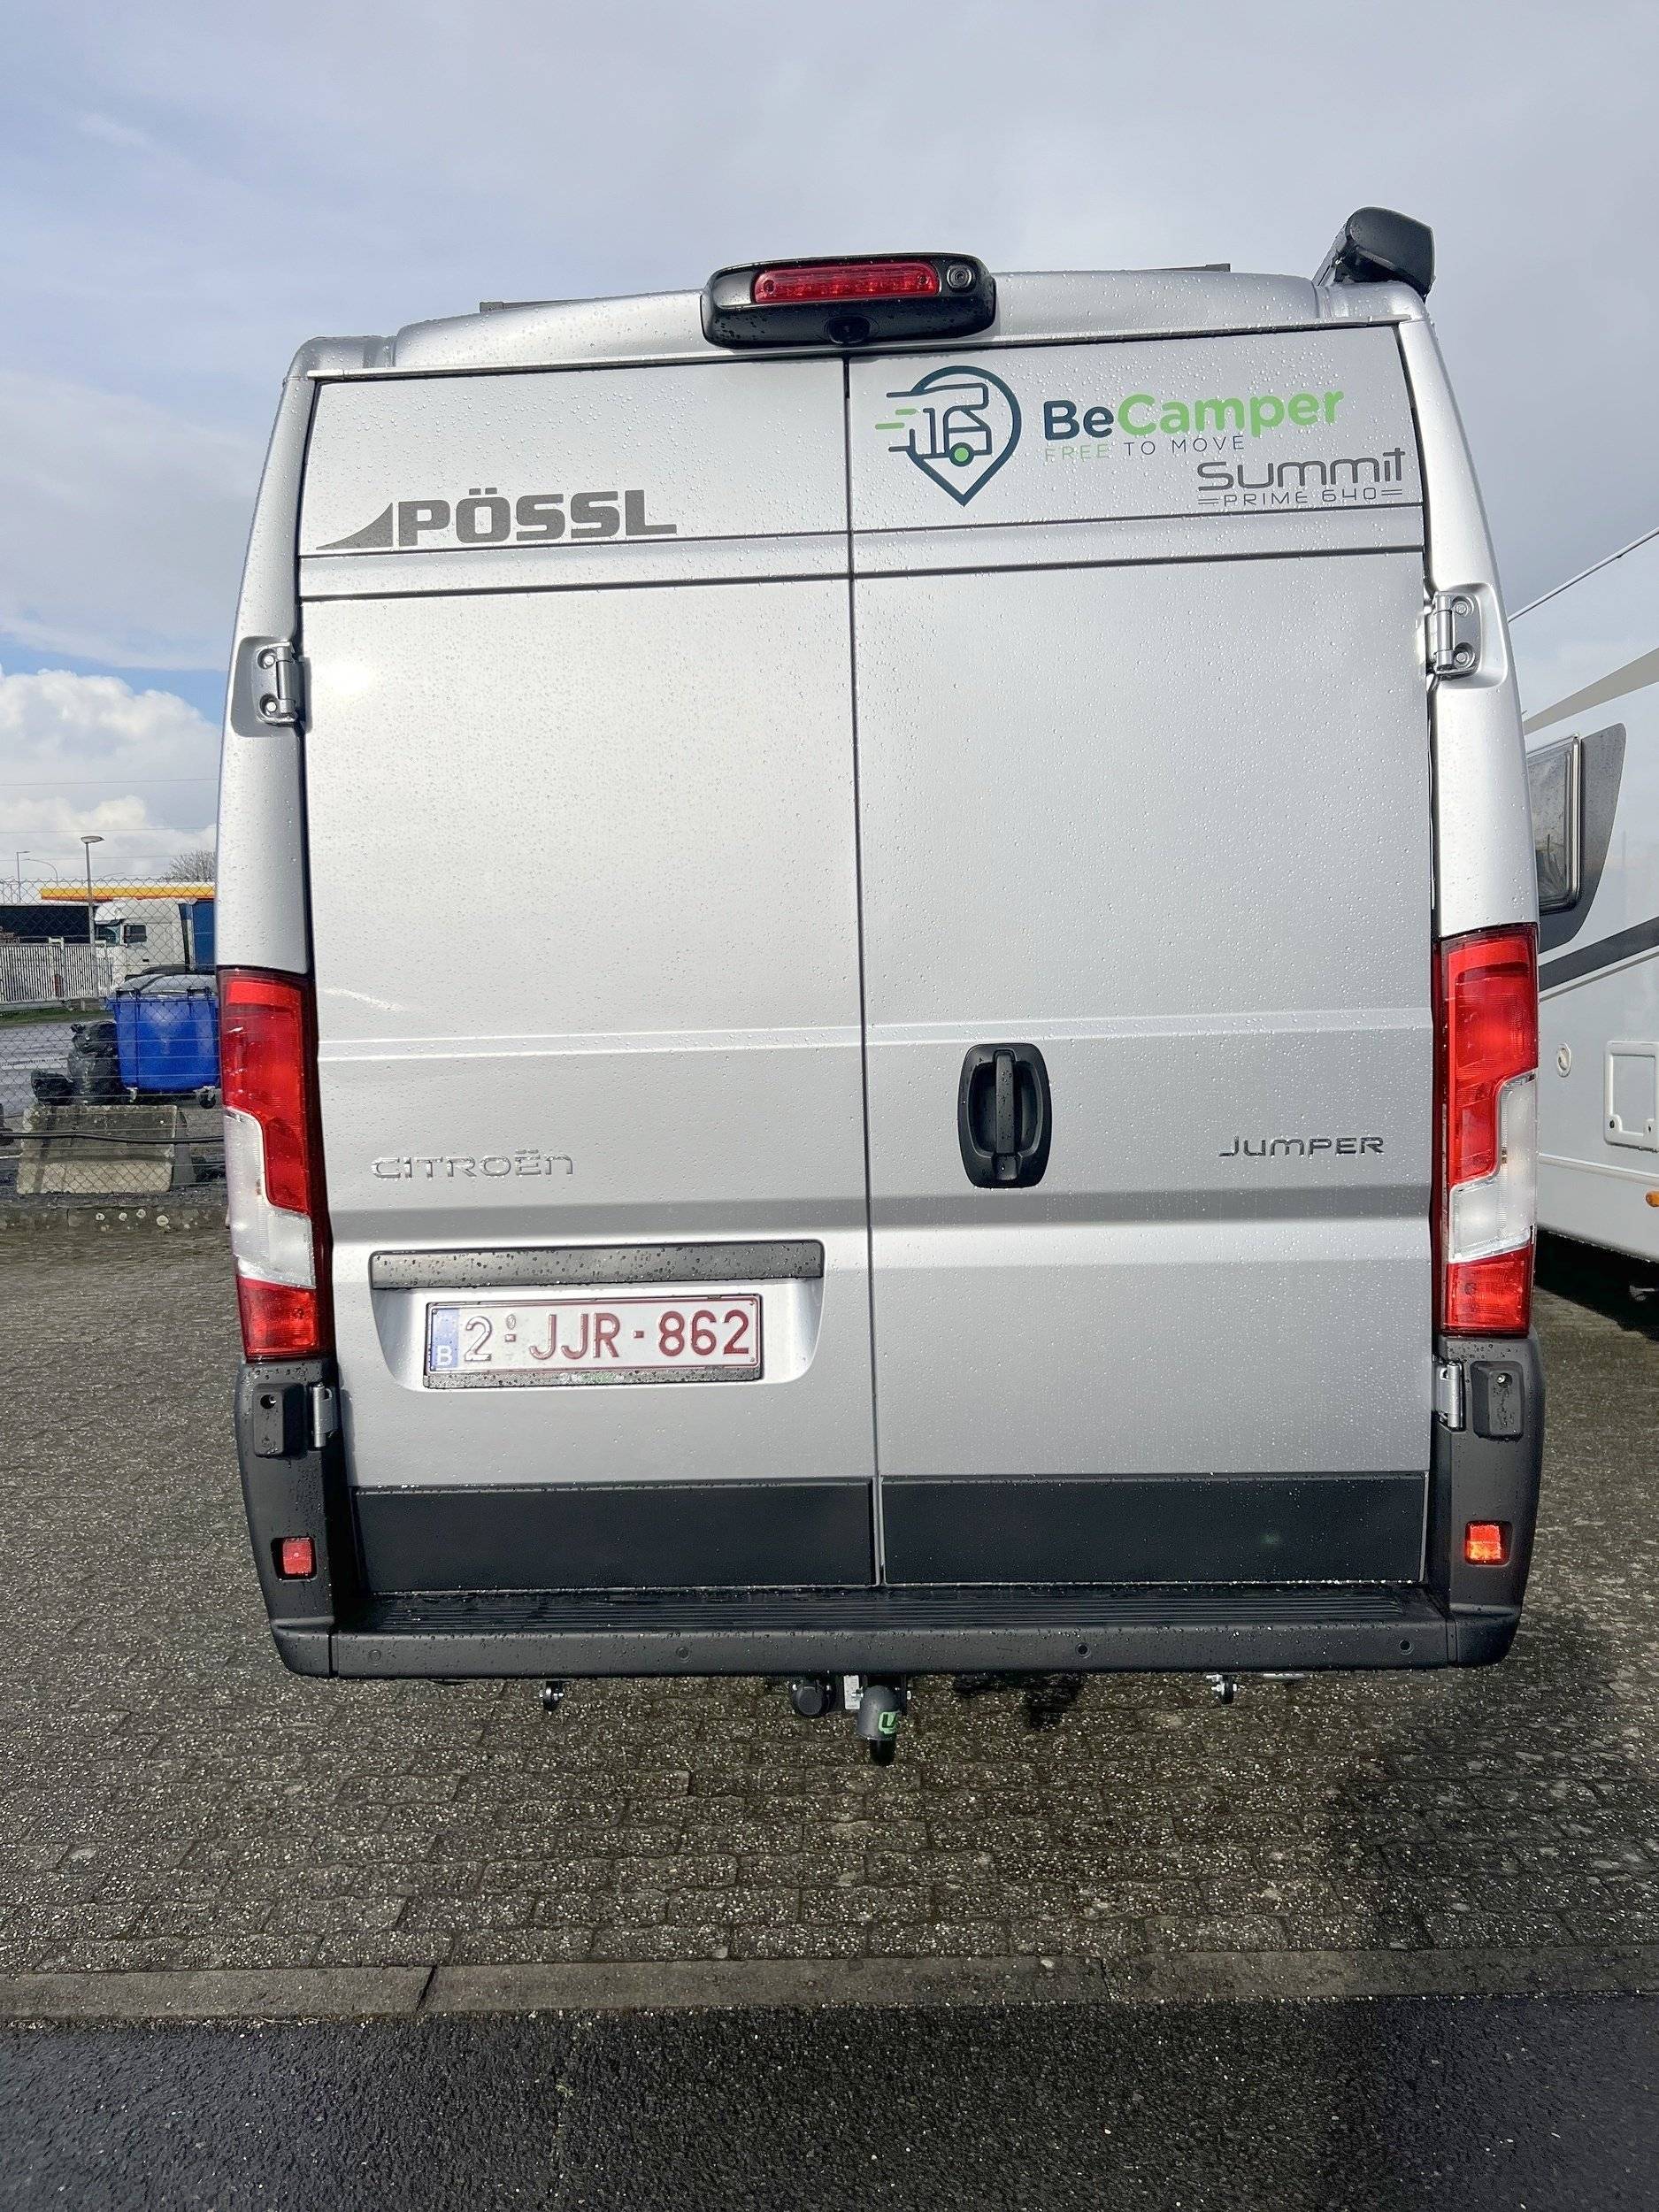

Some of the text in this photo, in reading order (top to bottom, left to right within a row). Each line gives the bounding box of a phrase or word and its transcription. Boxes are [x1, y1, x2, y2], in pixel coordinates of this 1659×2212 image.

[1043, 389, 1345, 442] BeCamper
[1044, 434, 1245, 462] FREE TO MOVE
[1224, 487, 1377, 507] PRIME 640
[397, 487, 678, 547] PÖSSL
[1218, 1136, 1385, 1158] JUMPER
[436, 1345, 453, 1367] B
